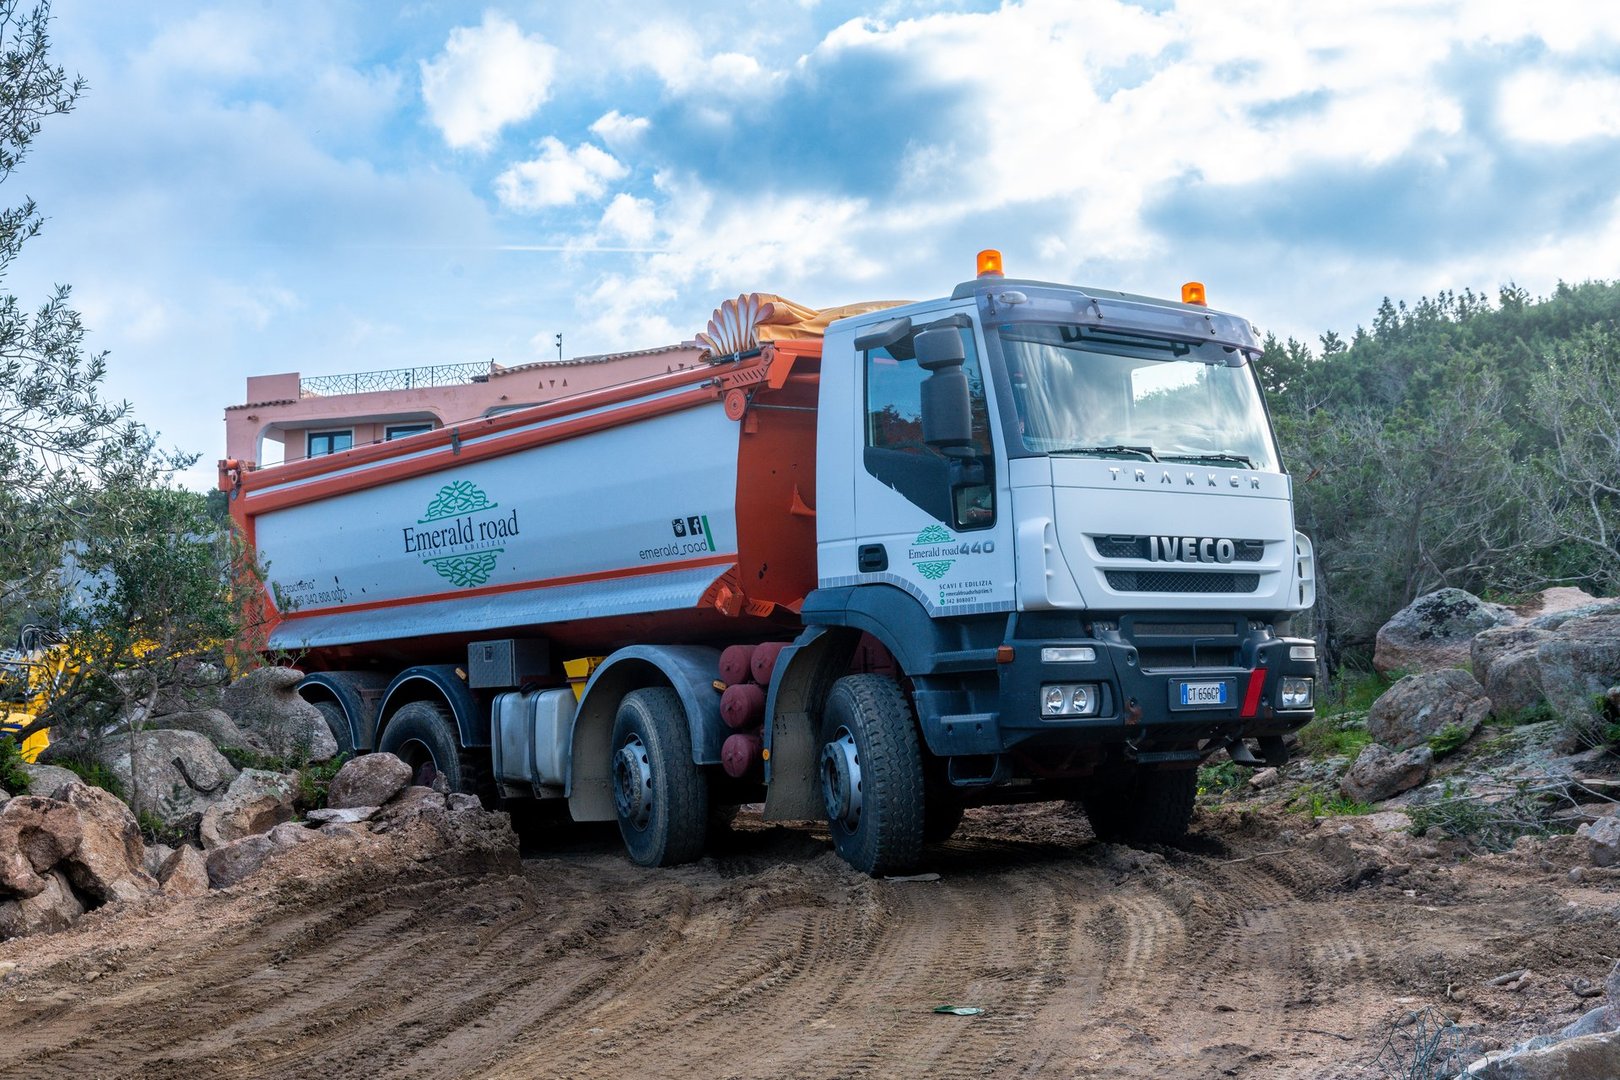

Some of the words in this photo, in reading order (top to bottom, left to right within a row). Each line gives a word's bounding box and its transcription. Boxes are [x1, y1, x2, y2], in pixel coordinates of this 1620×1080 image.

[1108, 467, 1260, 490] TRAKKER
[402, 517, 474, 553] Emerald
[479, 508, 520, 541] road
[639, 538, 708, 560] emerald_road
[908, 547, 940, 559] Emerald
[942, 545, 959, 556] road
[960, 541, 995, 555] 440
[1150, 536, 1236, 563] IVECO
[965, 580, 993, 588] EDILIZIA
[1188, 688, 1196, 701] CT
